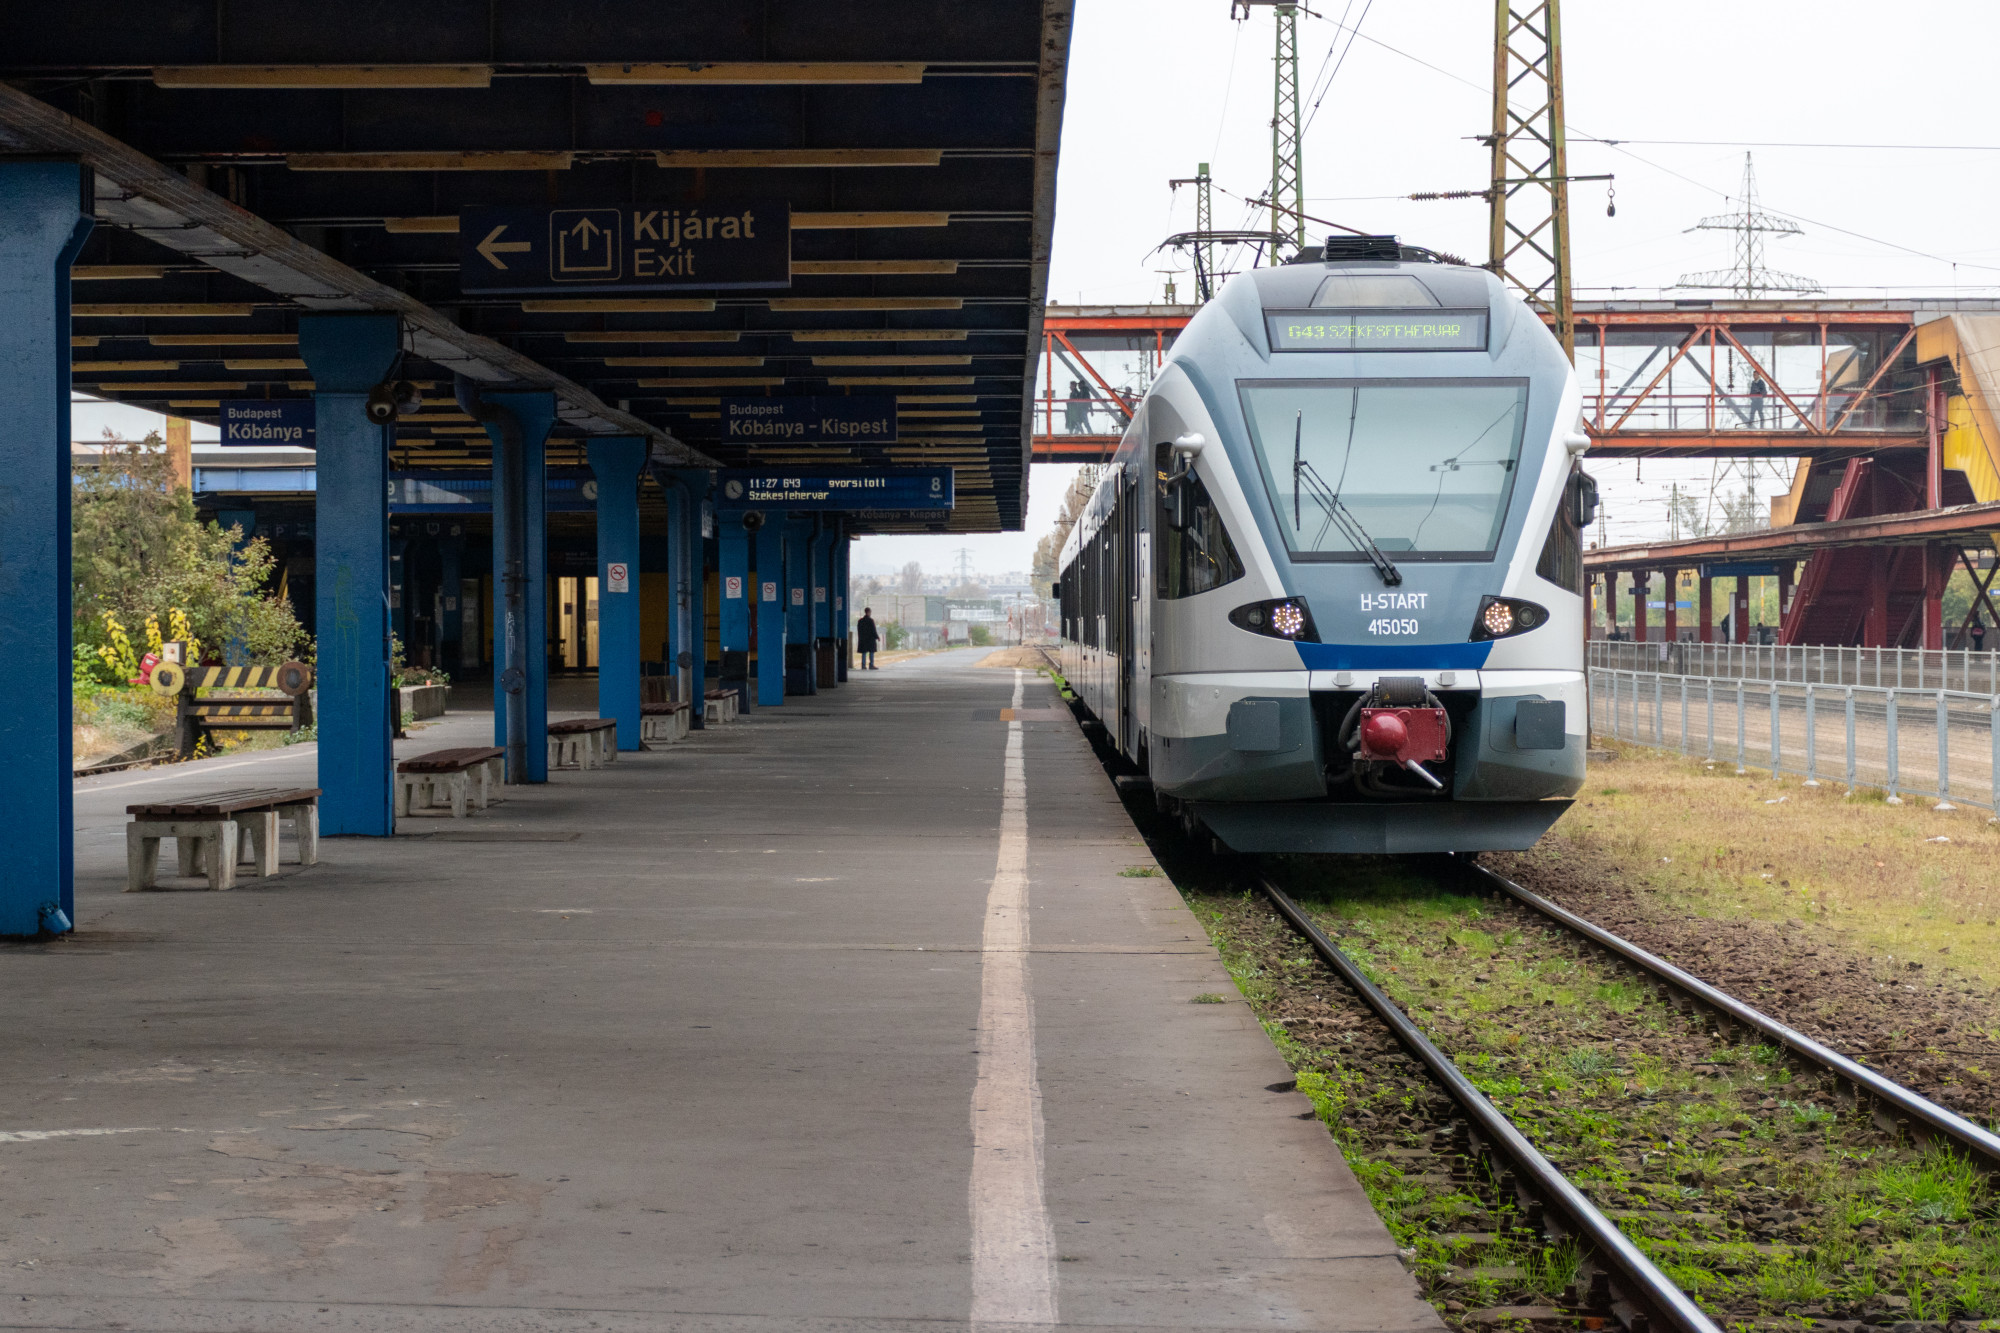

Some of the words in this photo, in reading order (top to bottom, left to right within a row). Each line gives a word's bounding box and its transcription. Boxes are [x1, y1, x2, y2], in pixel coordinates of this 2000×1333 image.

[633, 209, 755, 248] Kijárat
[634, 247, 696, 277] Exit
[1288, 325, 1325, 339] G43
[228, 407, 282, 420] Budapest
[729, 404, 784, 417] Budapest
[228, 423, 303, 442] Kőbánya
[729, 418, 805, 438] Kőbánya
[821, 418, 888, 437] Kispest
[749, 478, 778, 489] 11:27
[931, 476, 941, 492] 8
[1360, 593, 1428, 611] H-START
[1368, 619, 1419, 635] 415050
